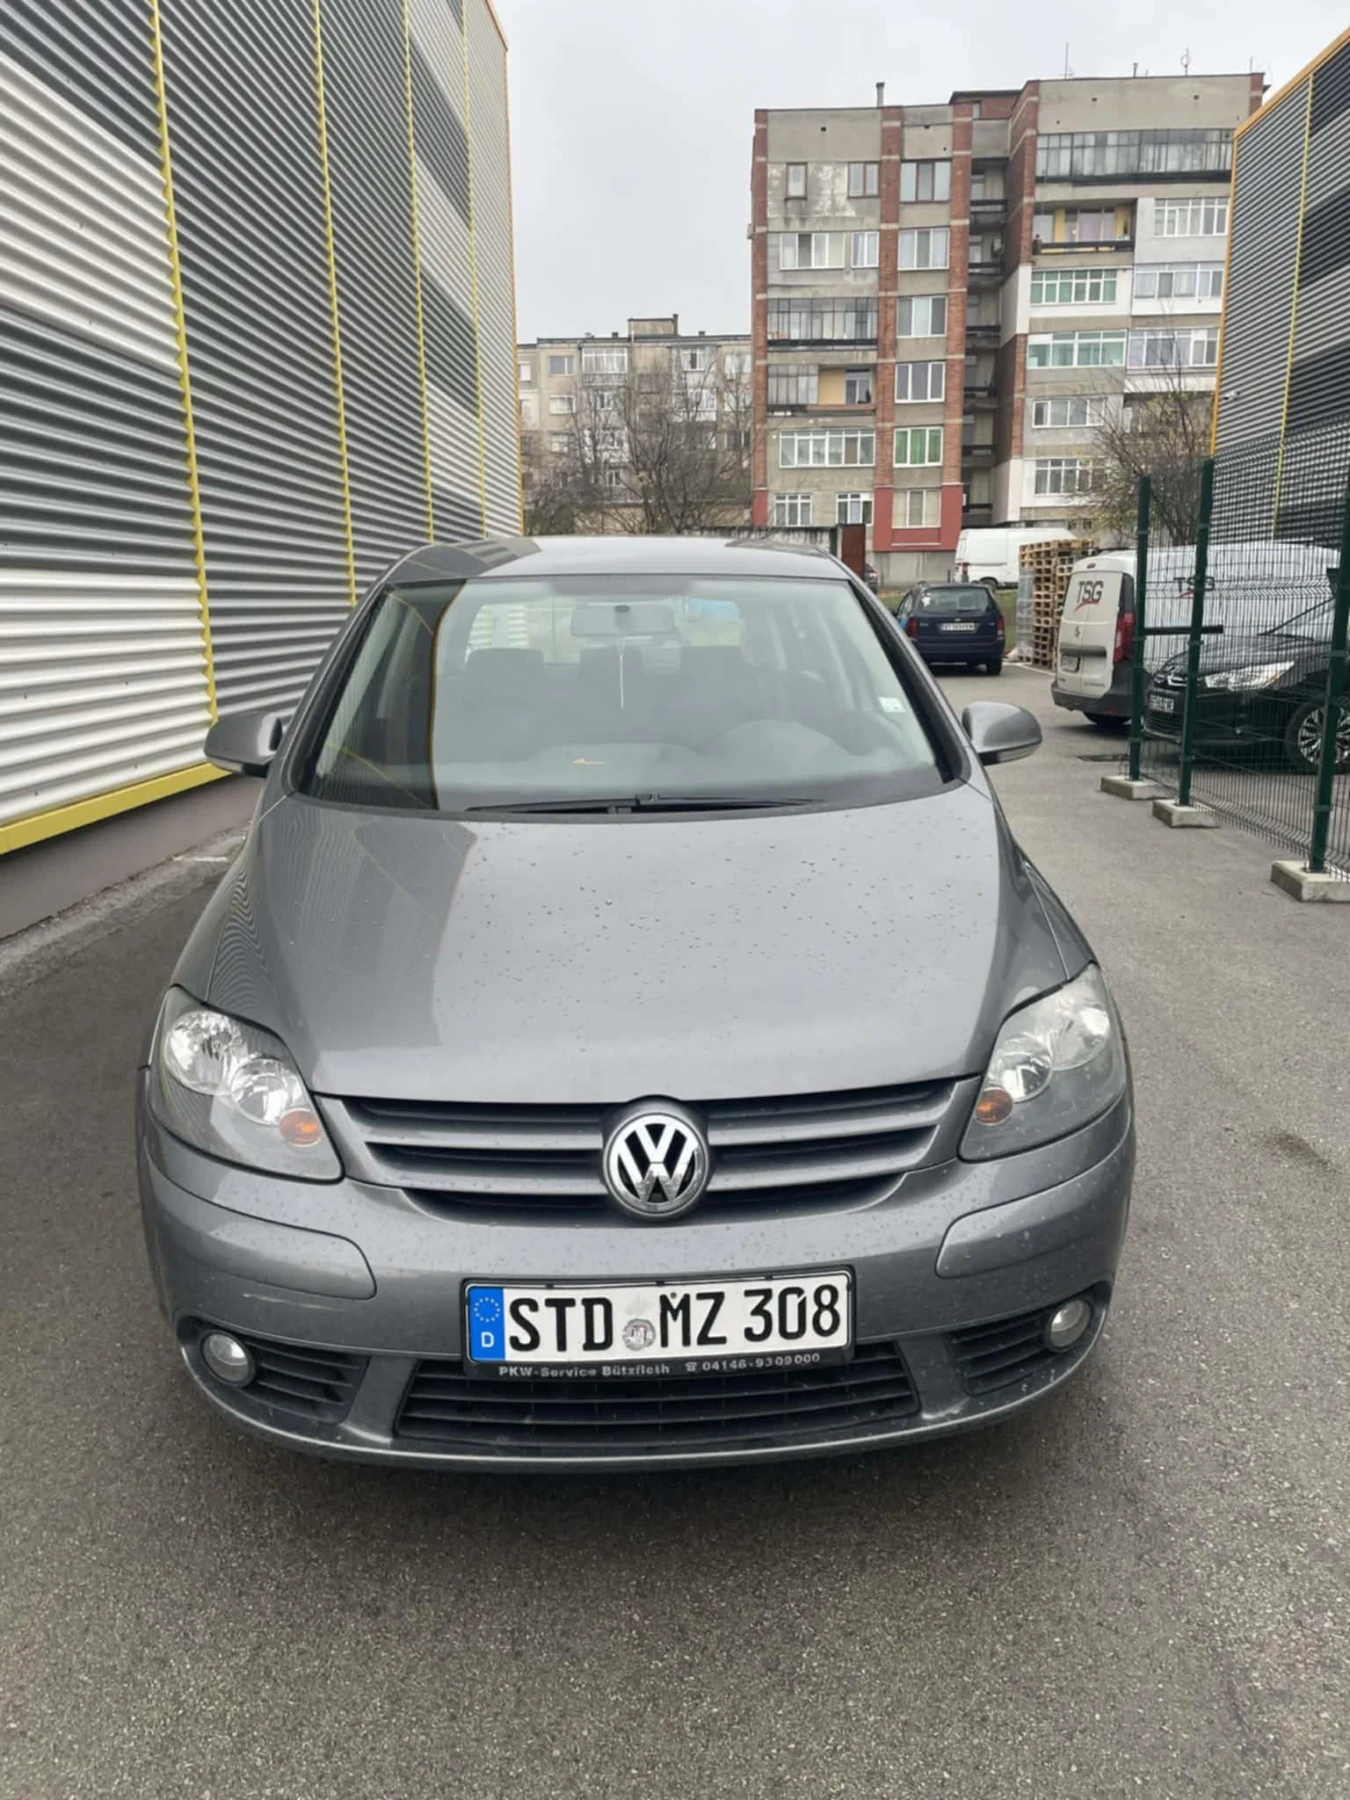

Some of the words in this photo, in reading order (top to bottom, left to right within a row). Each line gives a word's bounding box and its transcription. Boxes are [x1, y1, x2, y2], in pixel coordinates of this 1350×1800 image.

[1077, 580, 1104, 604] TSG
[509, 1297, 613, 1352] STD
[659, 1291, 727, 1348] MZ
[744, 1284, 841, 1342] 308
[481, 1332, 495, 1348] D
[499, 1366, 597, 1378] PKW-Service
